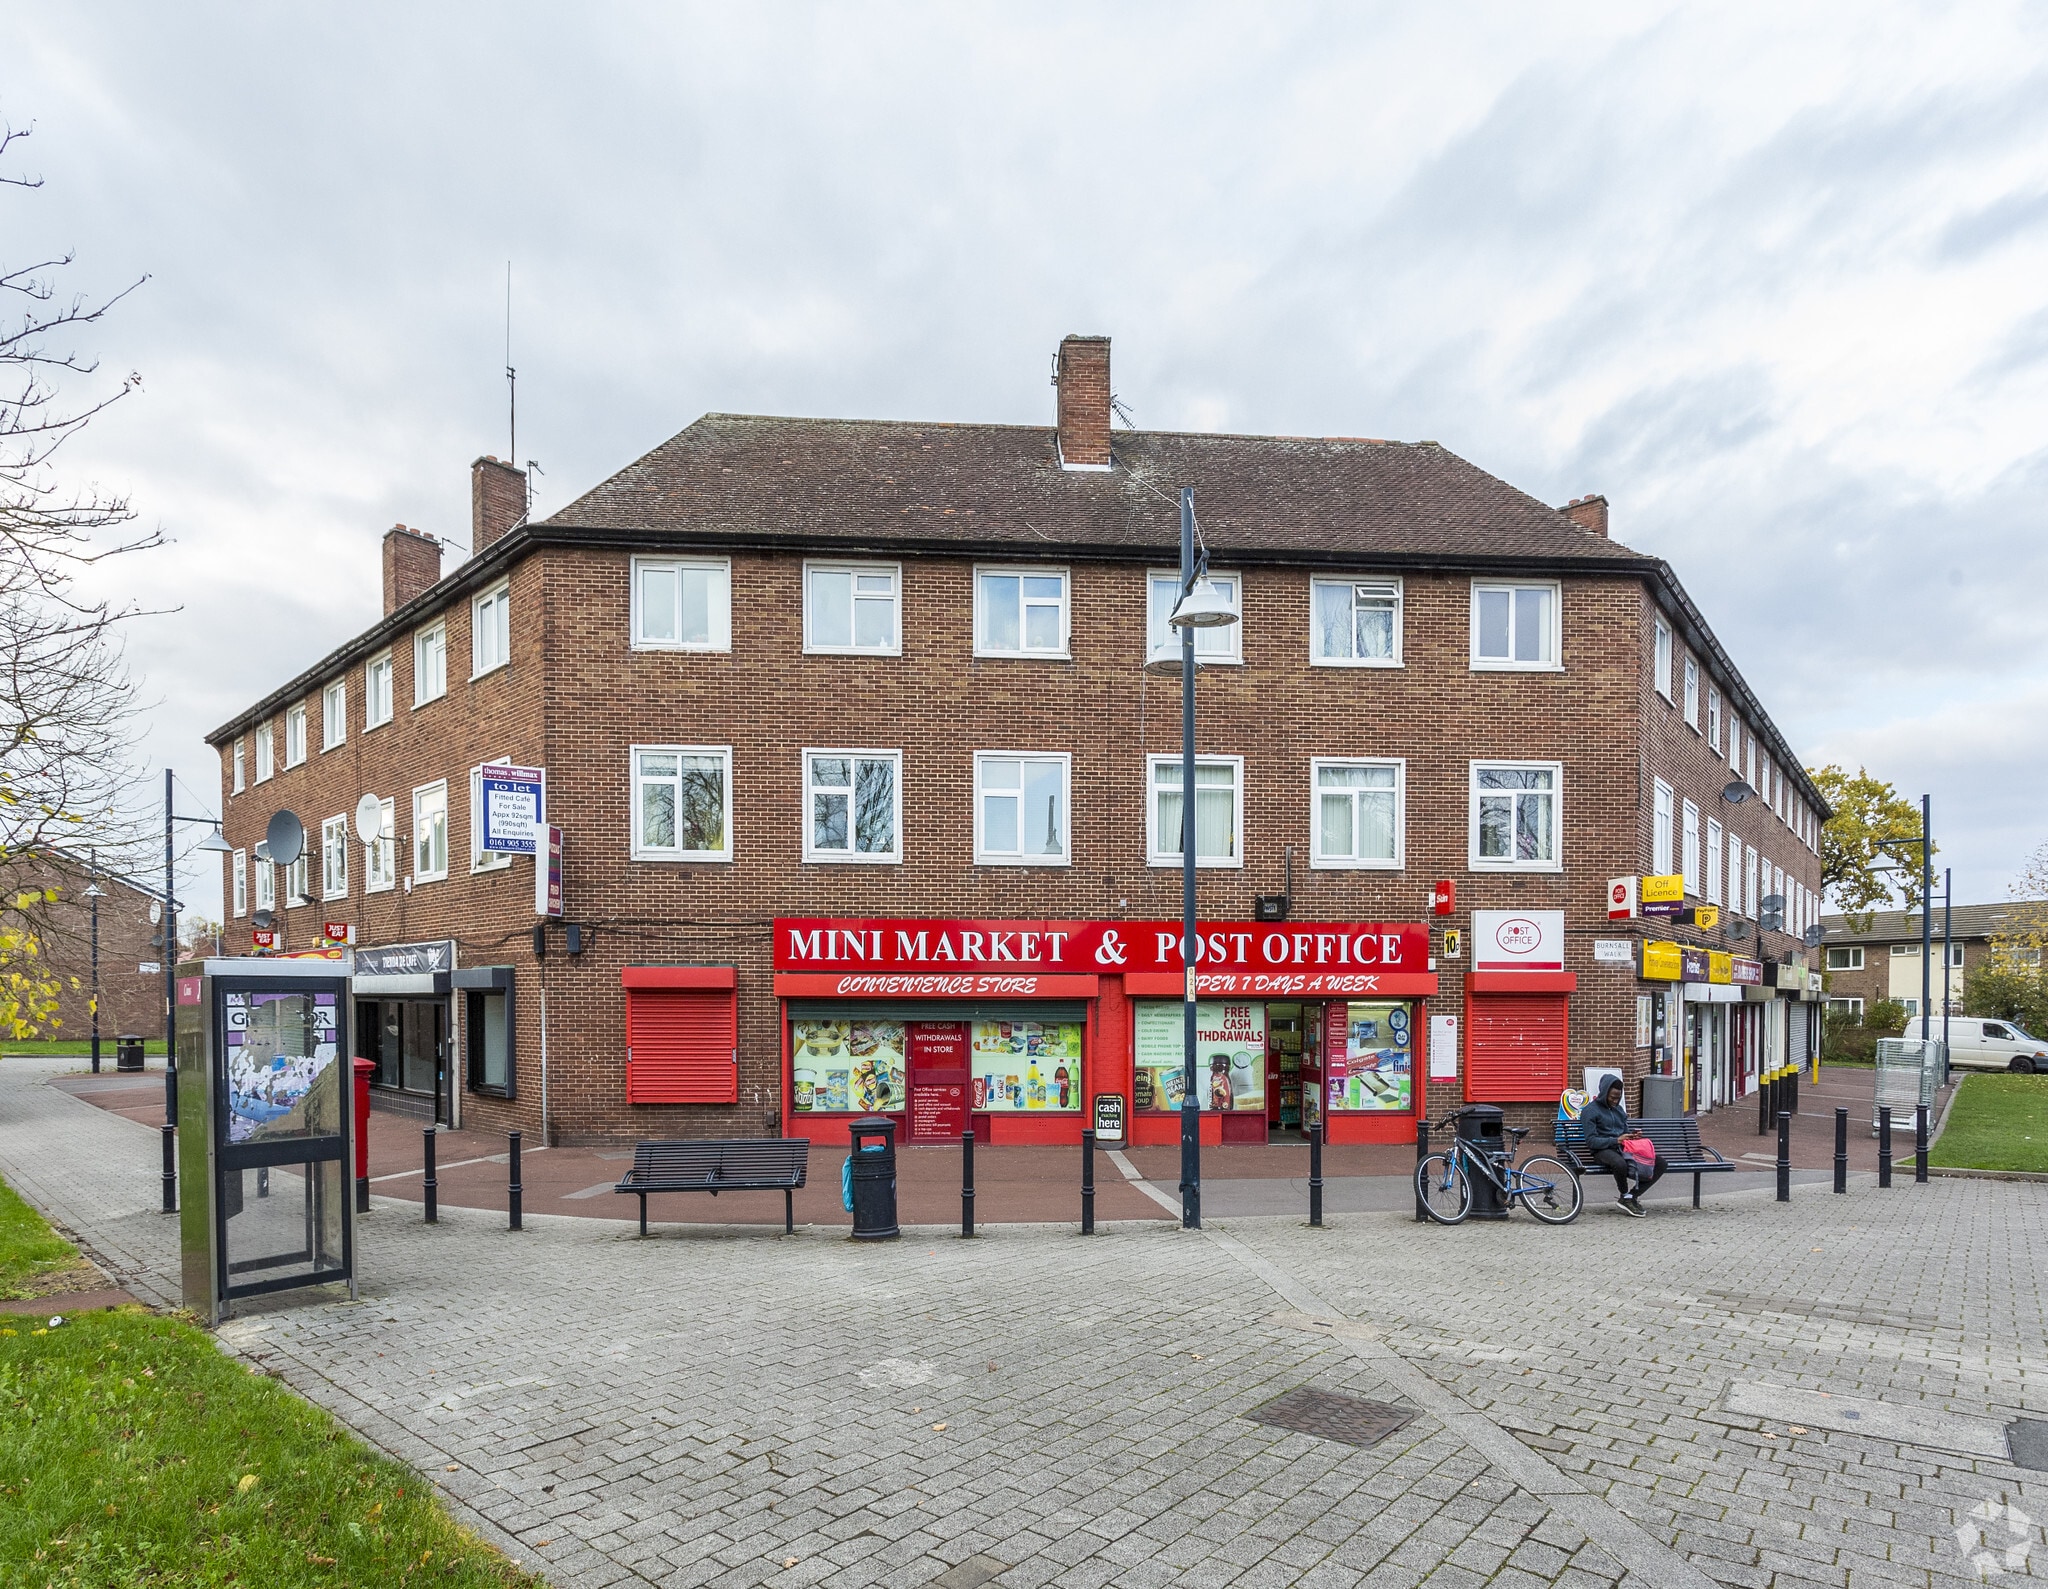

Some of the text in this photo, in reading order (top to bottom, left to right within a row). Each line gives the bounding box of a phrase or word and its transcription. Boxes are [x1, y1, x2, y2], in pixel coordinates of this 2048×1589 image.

[513, 783, 531, 792] let
[503, 828, 534, 836] Enquiries
[1646, 888, 1678, 897] Licence
[788, 929, 1403, 965] MINI MARKET & POST OFFICE
[837, 976, 1037, 995] CONVENIENCE STORE
[1196, 974, 1380, 994] PEN 7 DAYS A WEEK
[1224, 1006, 1250, 1018] FREE
[1224, 1019, 1251, 1030] CASH
[1197, 1031, 1263, 1042] THDRAWALS
[1347, 1054, 1376, 1065] Colgate
[1098, 1102, 1120, 1113] cash
[1098, 1117, 1120, 1128] here
